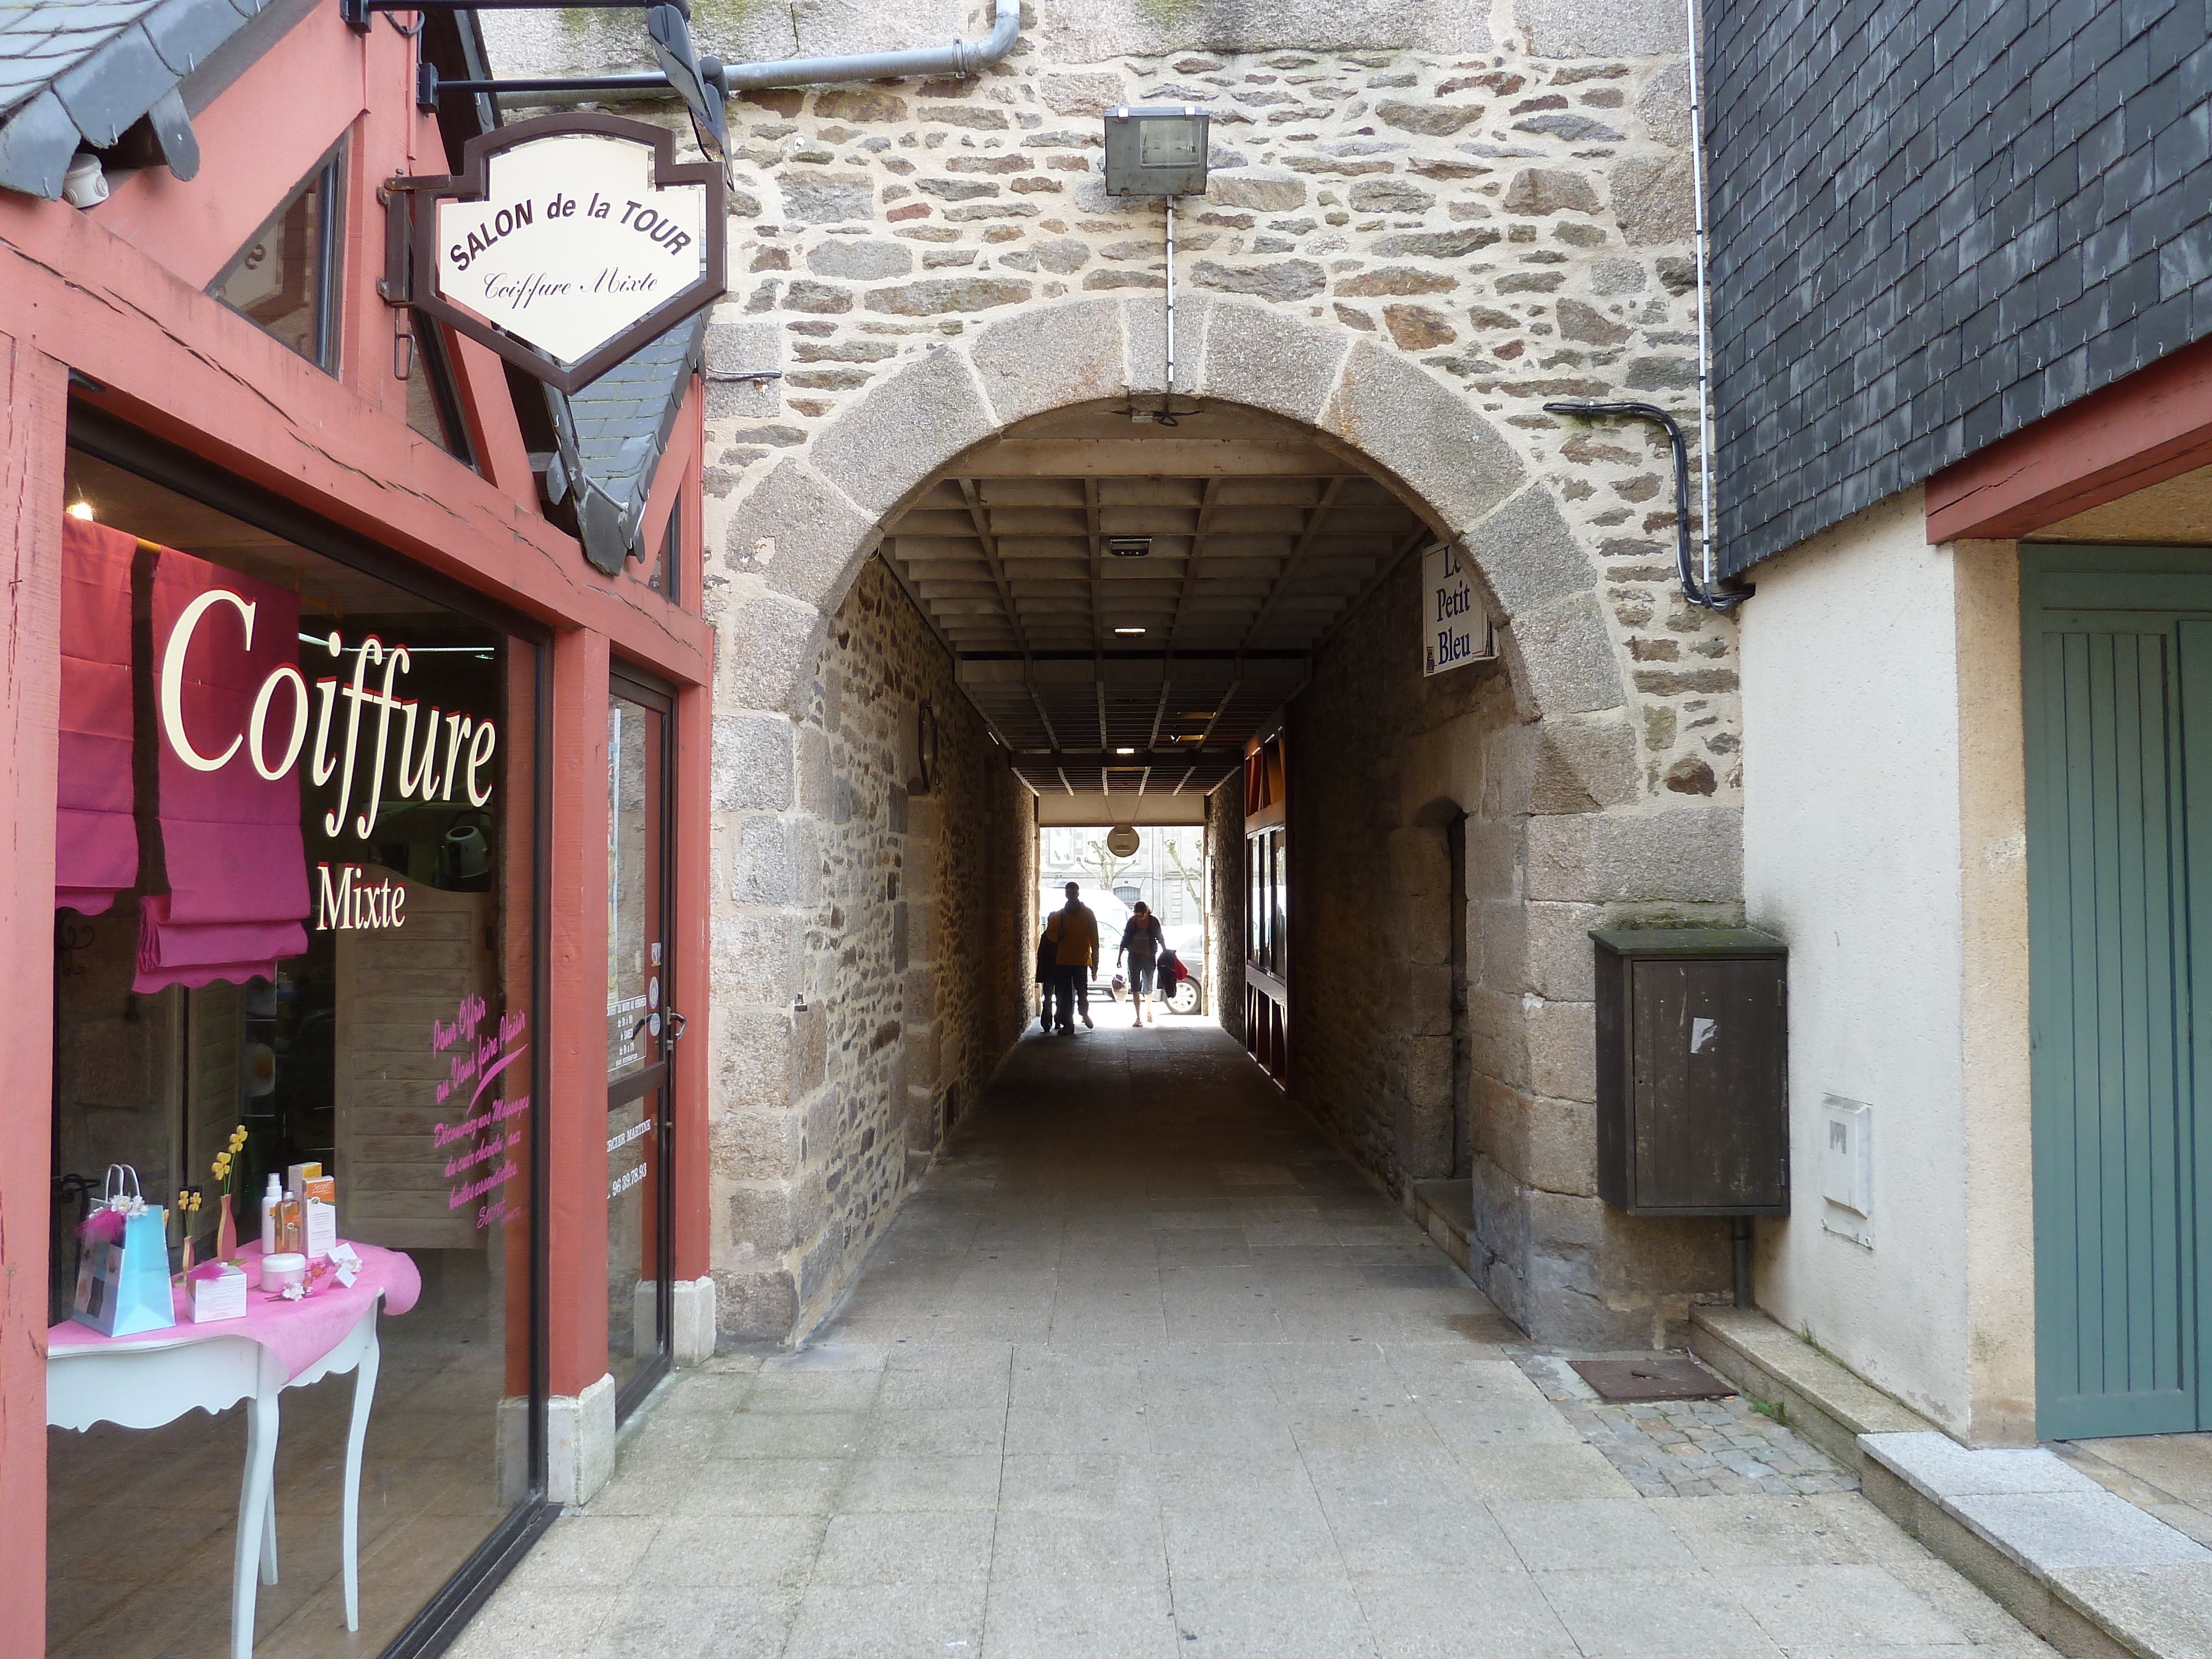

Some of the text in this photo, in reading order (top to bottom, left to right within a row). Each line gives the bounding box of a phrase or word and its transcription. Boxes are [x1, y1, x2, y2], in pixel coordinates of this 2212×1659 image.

[450, 192, 691, 272] SALON de la TOUR
[483, 267, 658, 309] Coiffure Mixte
[1437, 580, 1471, 622] Petit
[1438, 627, 1472, 665] Bleu
[161, 586, 496, 839] Coiffure
[316, 862, 406, 931] Mixte
[434, 992, 486, 1059] Pour Offrir
[451, 1052, 476, 1089] Vous
[478, 1034, 498, 1080] faire
[500, 1009, 525, 1051] Plaisir
[434, 1094, 530, 1152] Découvrez nos Massages
[626, 1118, 651, 1142] MARTINE
